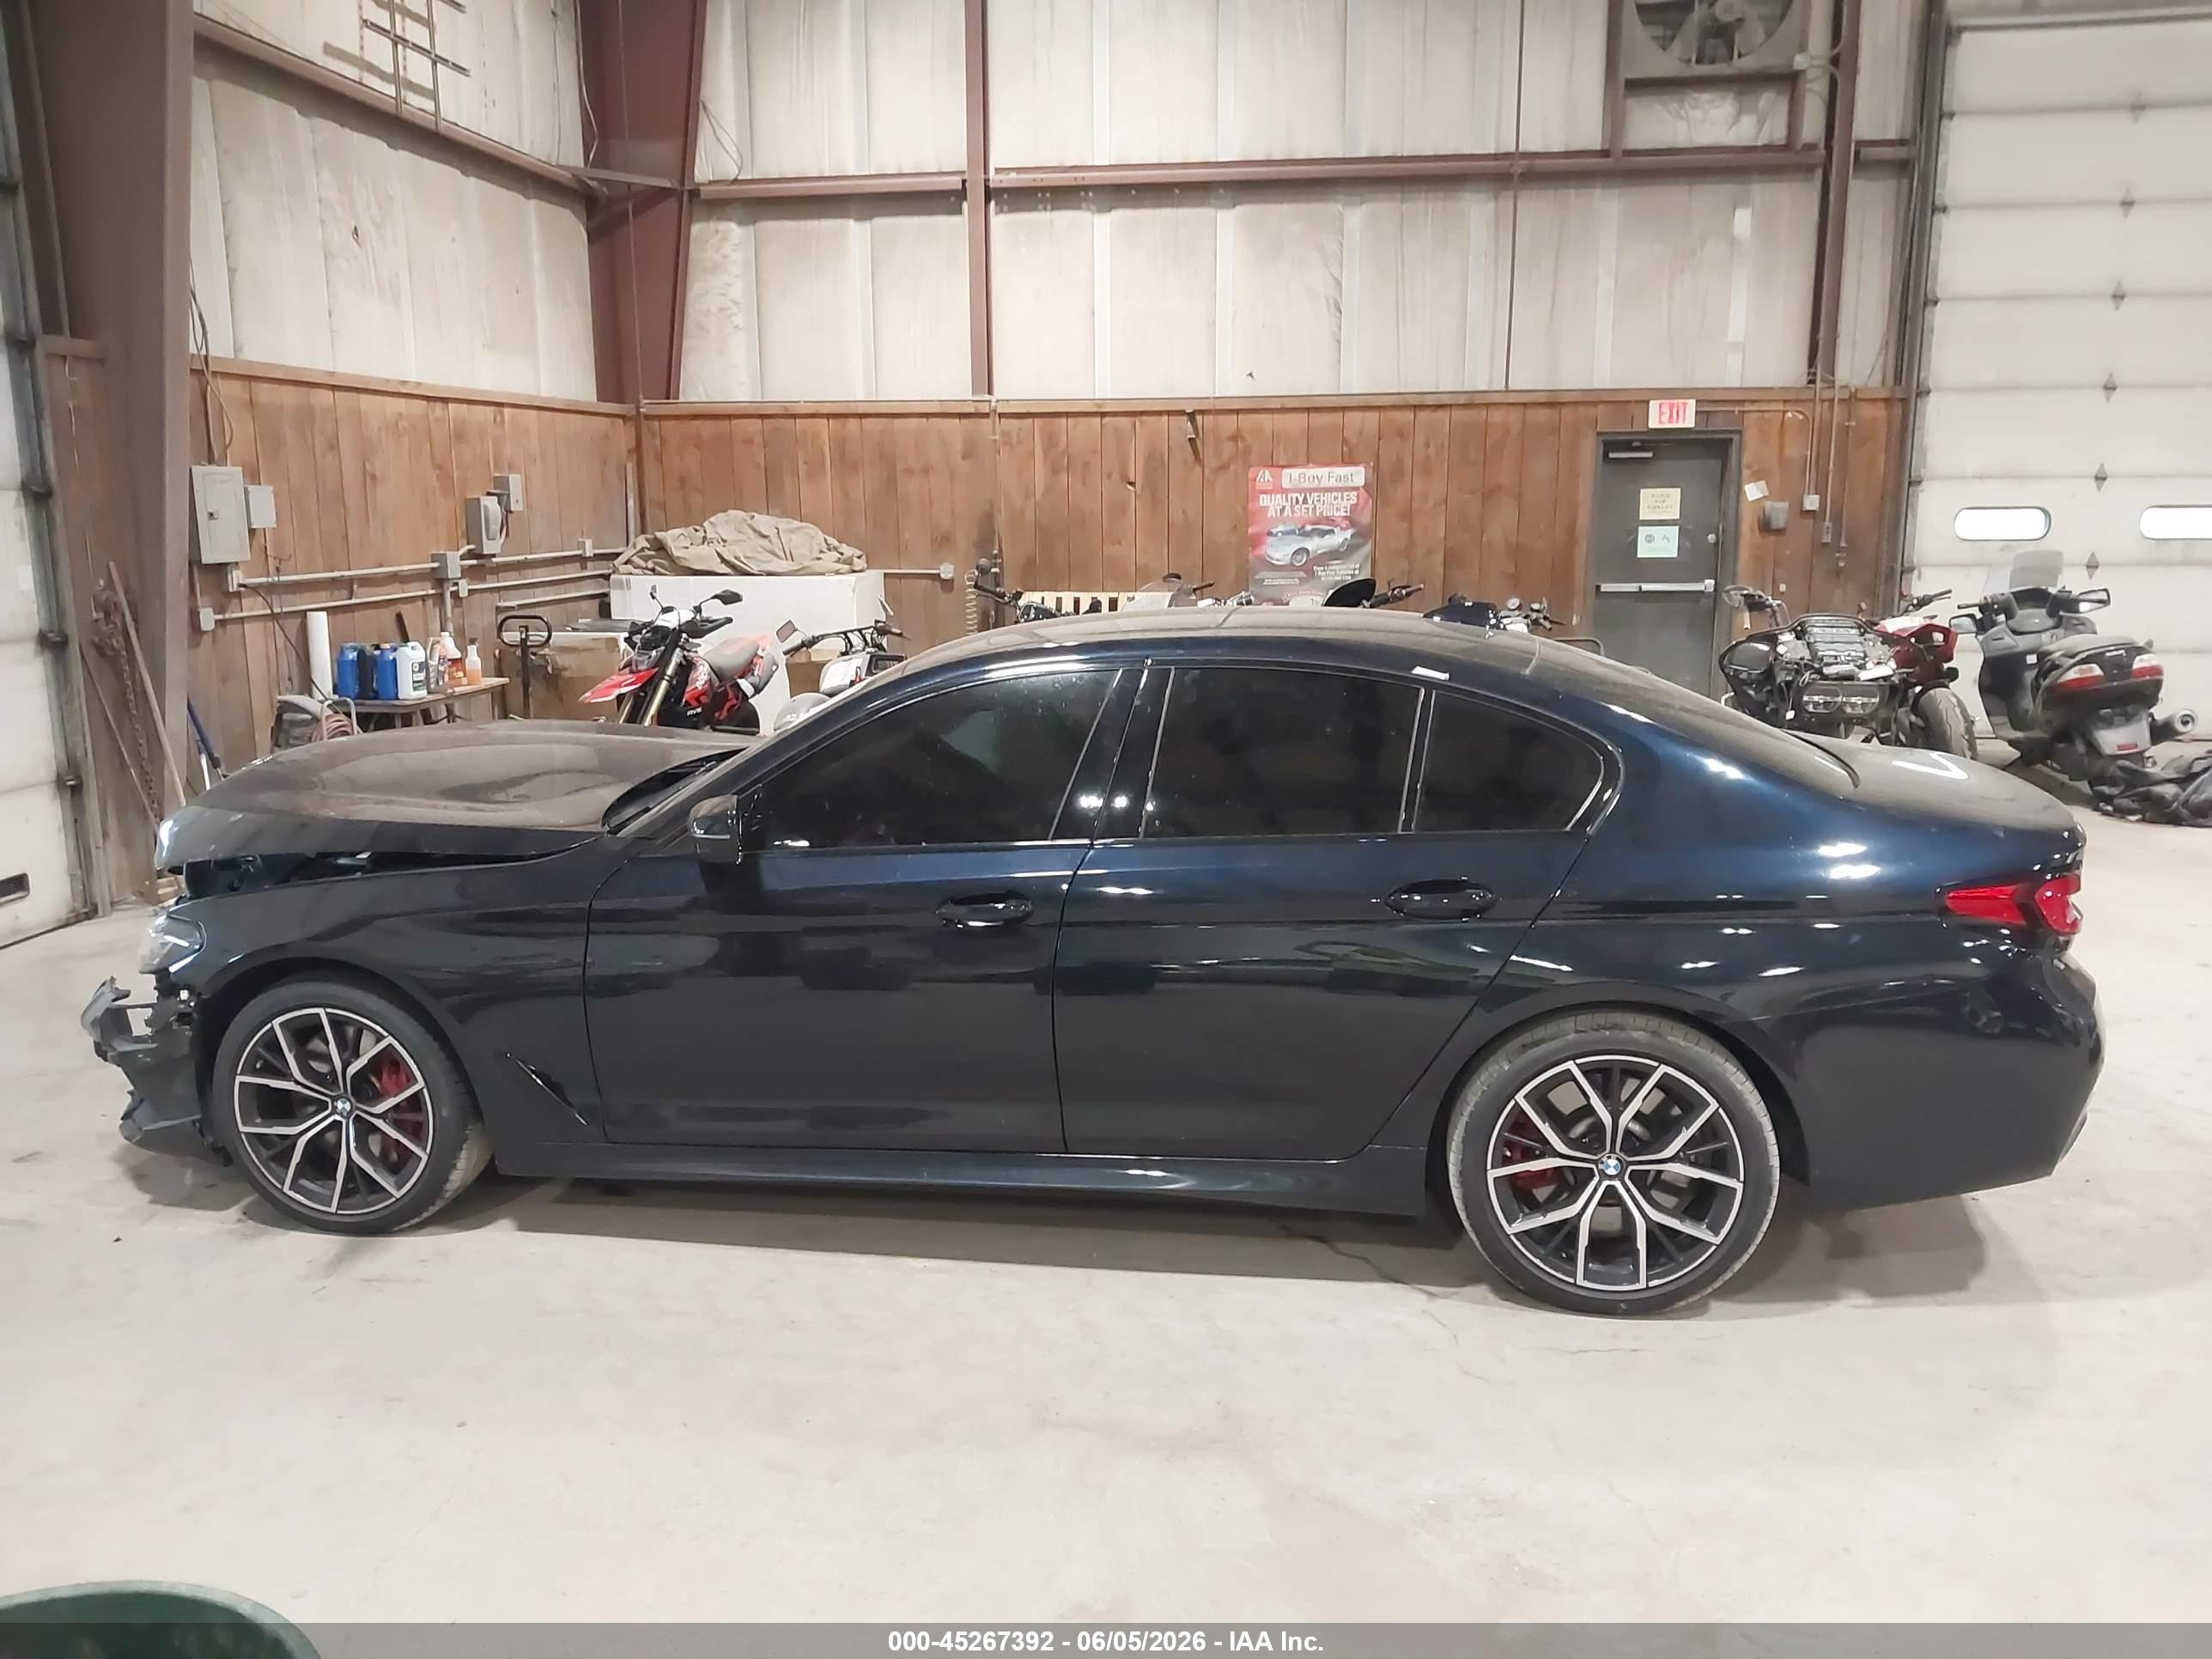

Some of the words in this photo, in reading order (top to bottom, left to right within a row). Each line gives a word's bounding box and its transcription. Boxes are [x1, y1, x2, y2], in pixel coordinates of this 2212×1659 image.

[1658, 402, 1689, 424] EXIT
[1289, 472, 1323, 485] I-Buy
[1328, 471, 1354, 483] Fast
[1259, 493, 1305, 507] QUALITY
[1306, 492, 1358, 504] VEHICLES
[1267, 505, 1283, 518] AT
[1283, 504, 1293, 518] A
[1294, 504, 1315, 517] SET
[1316, 504, 1351, 516] PRICE!
